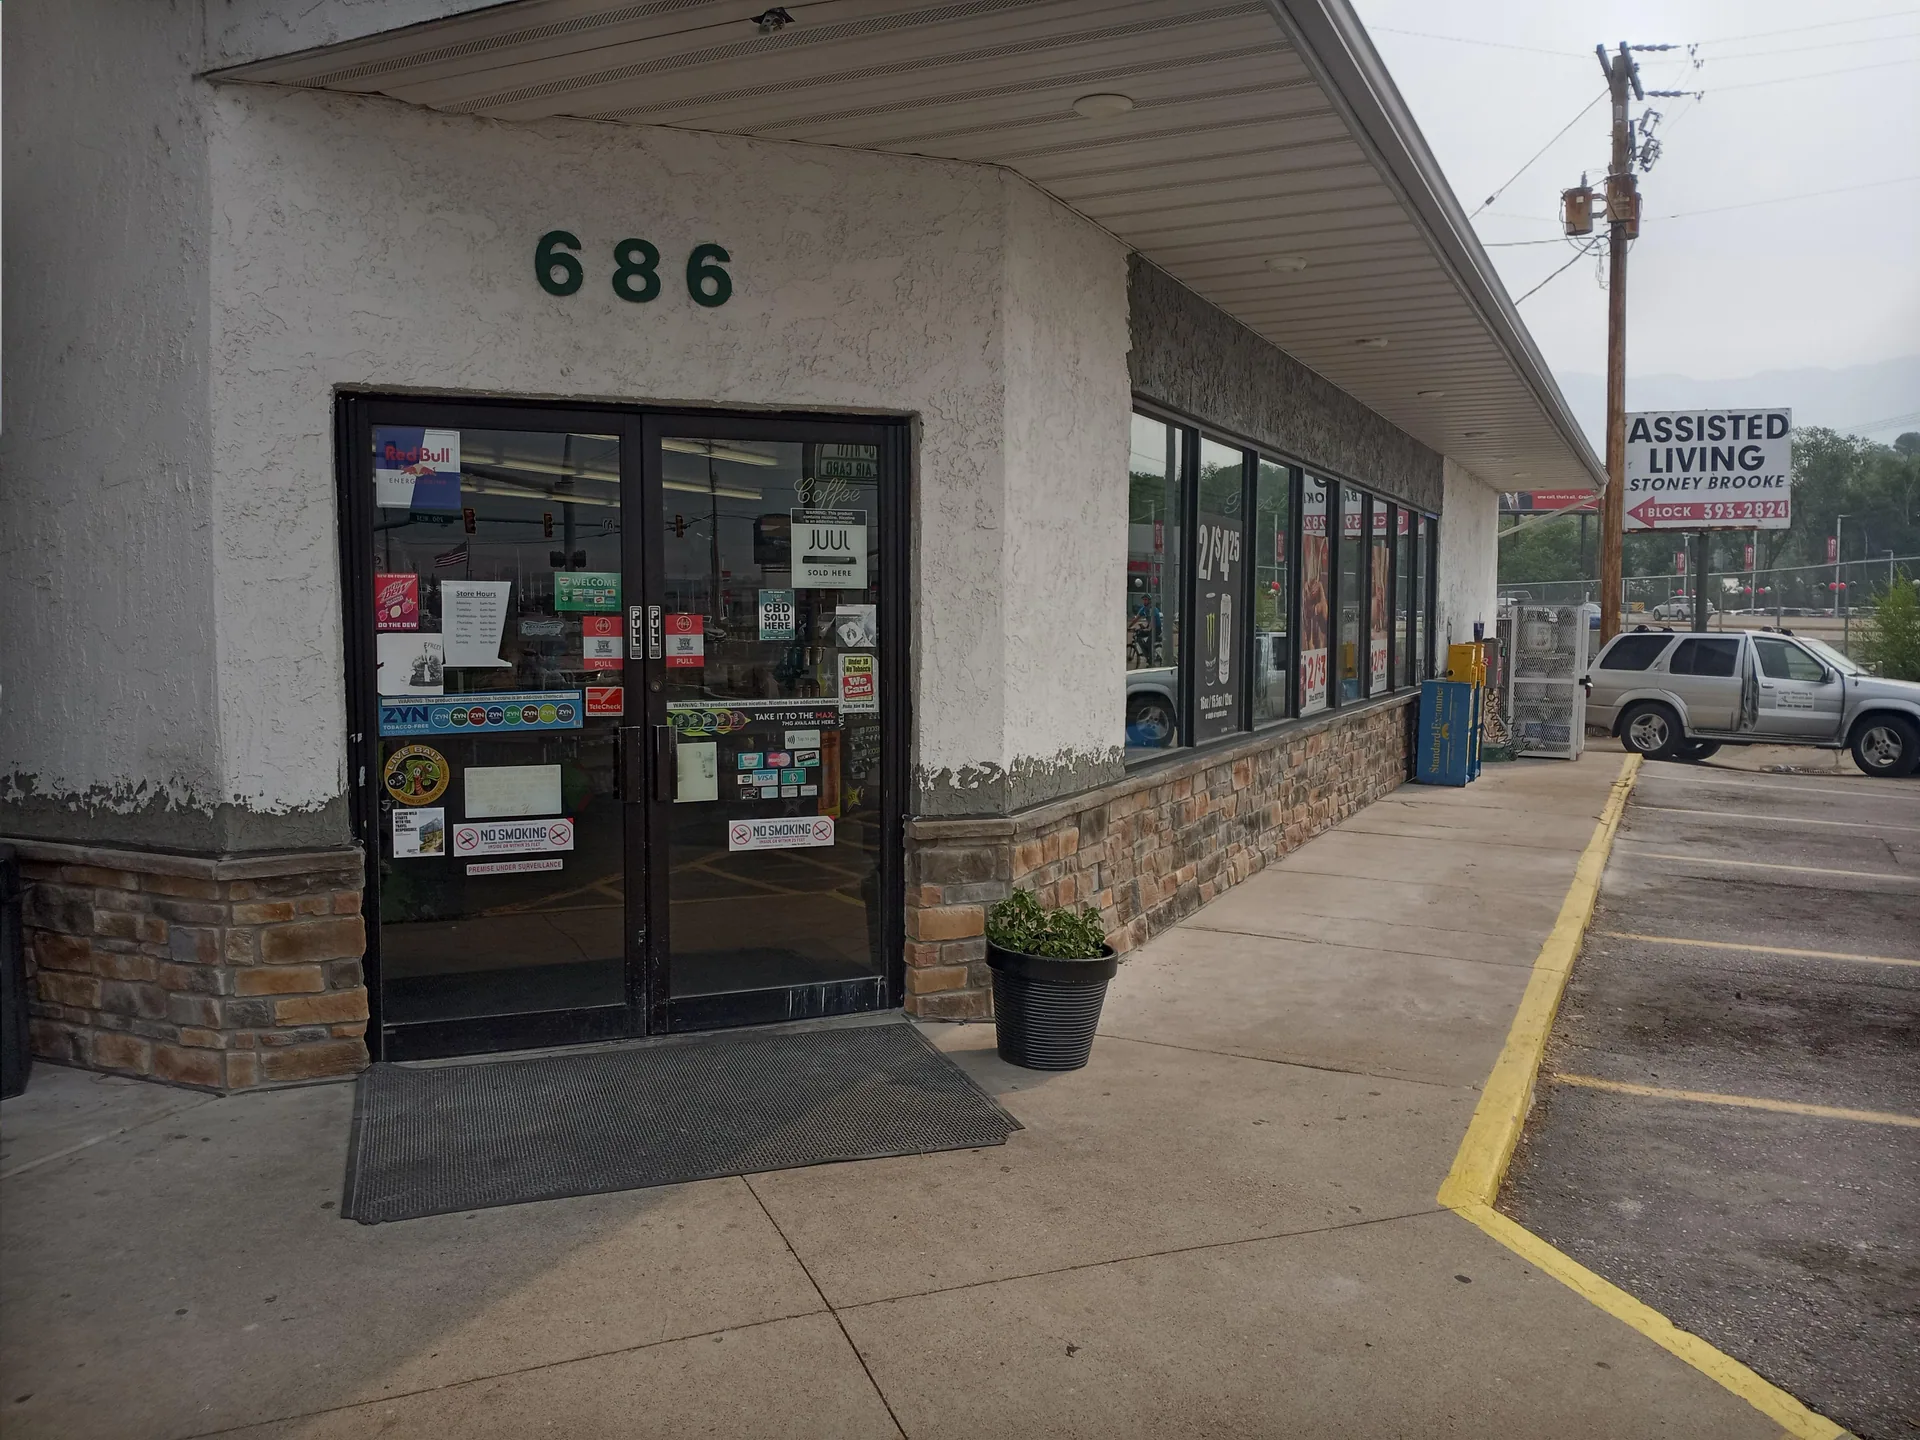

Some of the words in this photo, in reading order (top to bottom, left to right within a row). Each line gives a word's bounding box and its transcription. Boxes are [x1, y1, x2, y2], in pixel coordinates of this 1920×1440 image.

[535, 230, 732, 307] 686
[1628, 414, 1789, 444] ASSISTED
[385, 445, 417, 462] Red
[420, 448, 450, 462] Bull
[1650, 445, 1765, 474] LIVING
[1629, 476, 1703, 492] STONEY
[1707, 475, 1785, 490] BROOKE
[794, 477, 860, 509] Coffee
[1638, 508, 1644, 518] 1
[1648, 507, 1692, 518] BLOCK
[1703, 502, 1786, 519] 393-2824
[809, 529, 850, 550] JUUL
[572, 578, 617, 587] WELCOME
[476, 590, 497, 598] Hours
[764, 603, 791, 613] CBD
[764, 613, 791, 622] SOLD
[632, 610, 640, 646] PULL
[650, 610, 659, 646] PULL
[764, 622, 791, 630] HERE
[594, 660, 613, 668] PULL
[848, 676, 867, 686] We
[844, 684, 872, 694] Card
[382, 706, 429, 724] ZYN
[754, 713, 776, 721] TAKE
[786, 712, 798, 720] TO
[798, 712, 814, 720] THE
[815, 711, 836, 719] MAX.
[387, 748, 410, 771] LIVE
[414, 746, 443, 762] BAIT
[480, 829, 496, 841] NO
[498, 827, 547, 840] SMOKING
[753, 825, 766, 837] NO
[768, 823, 811, 836] SMOKING
[468, 865, 495, 873] PREMISE
[496, 864, 517, 872] UNDER
[518, 861, 562, 870] SURVEILLANCE
